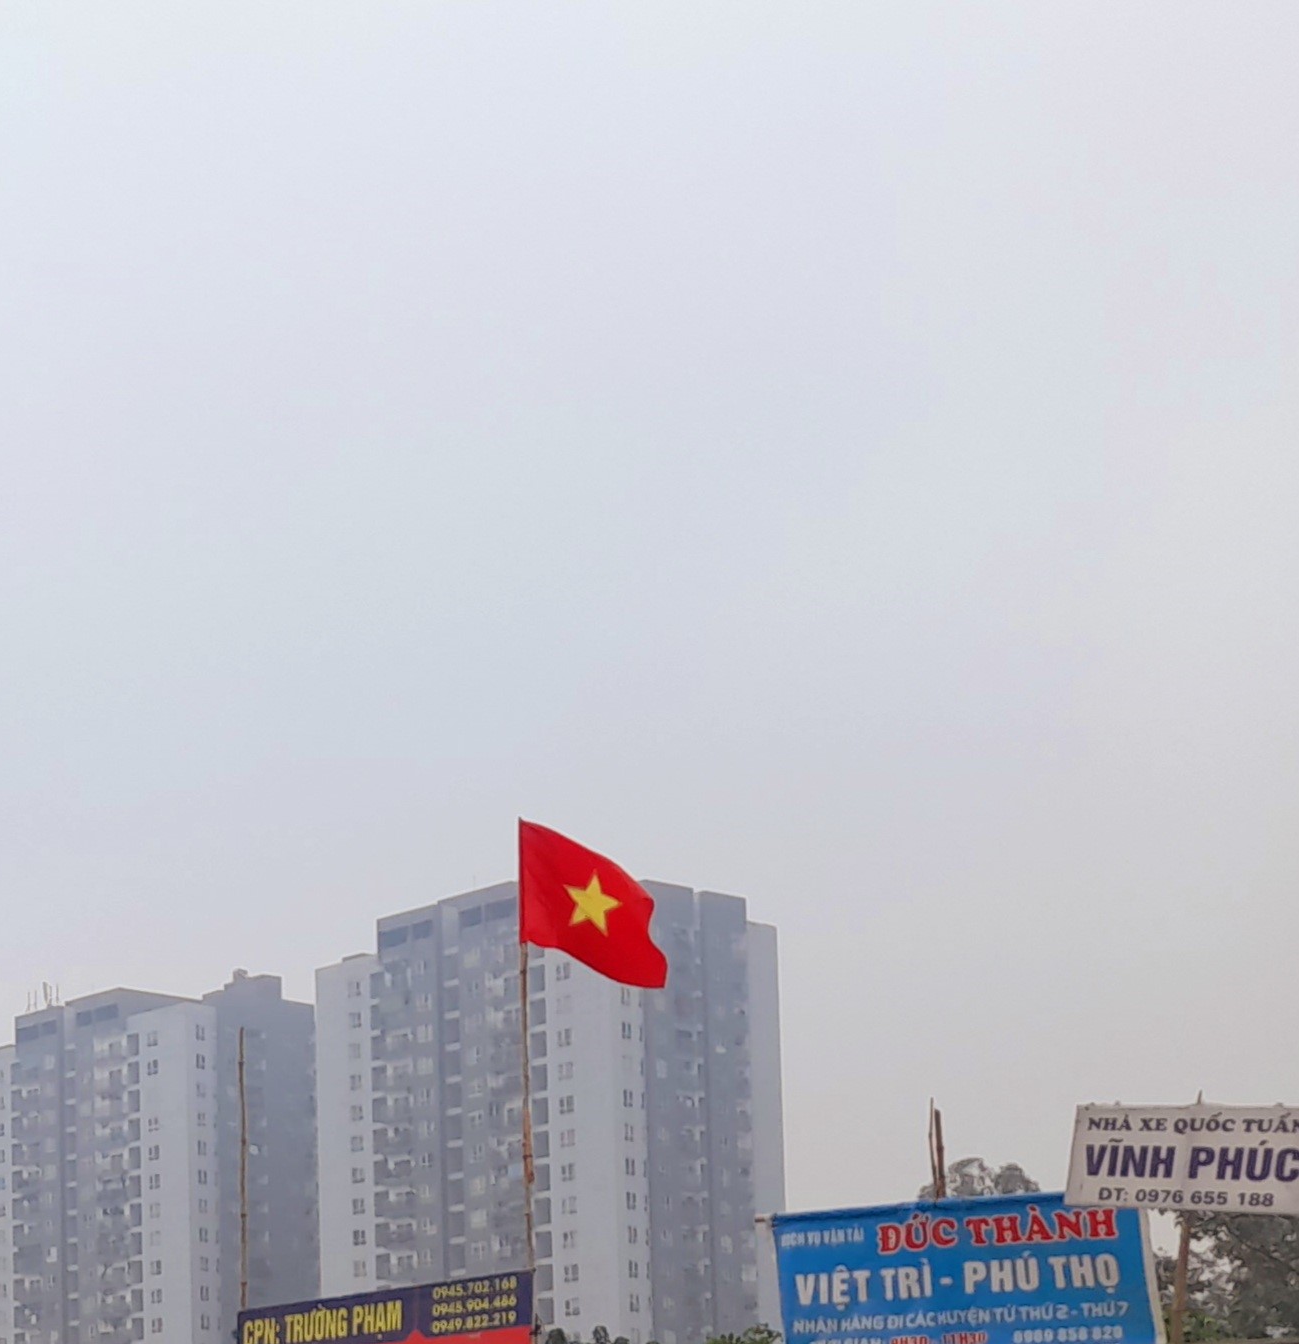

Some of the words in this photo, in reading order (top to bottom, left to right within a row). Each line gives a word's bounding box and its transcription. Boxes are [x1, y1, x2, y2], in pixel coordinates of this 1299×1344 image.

[1087, 1114, 1132, 1131] NHÀ
[1139, 1117, 1167, 1131] XE
[1173, 1112, 1235, 1134] QUỐC
[1086, 1138, 1176, 1178] VĨNH
[1188, 1140, 1299, 1182] PHÚC
[1135, 1189, 1183, 1204] 0976
[1190, 1191, 1228, 1206] 655
[1237, 1192, 1274, 1207] 188
[877, 1212, 958, 1254] ĐỨC
[965, 1204, 1119, 1246] THÀNH
[795, 1264, 871, 1311] VIỆT
[880, 1258, 933, 1301] TRÌ
[963, 1250, 1040, 1295] PHÚ
[1048, 1253, 1120, 1294] THỌ
[285, 1304, 348, 1344] TRƯỜNG
[352, 1300, 402, 1340] PHẠM
